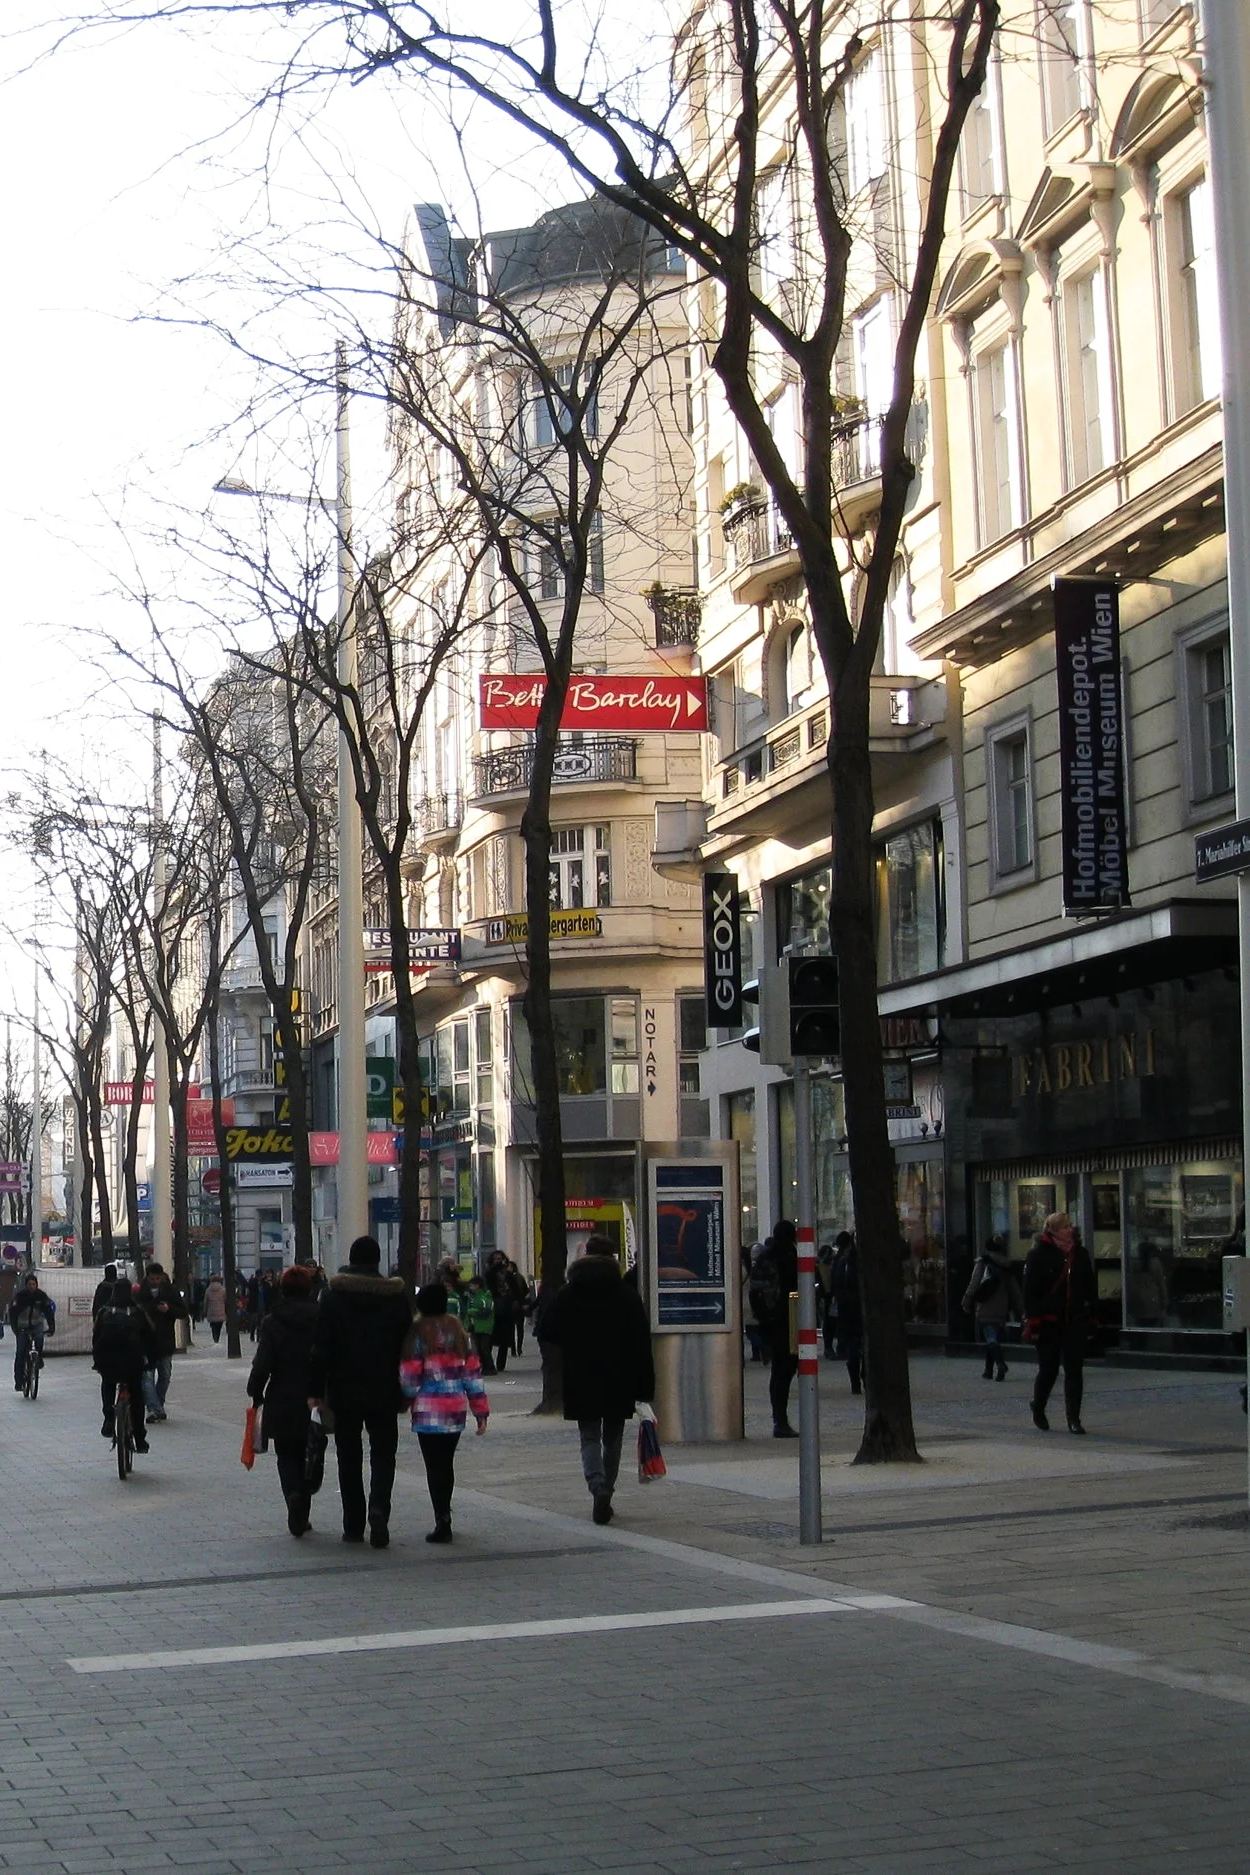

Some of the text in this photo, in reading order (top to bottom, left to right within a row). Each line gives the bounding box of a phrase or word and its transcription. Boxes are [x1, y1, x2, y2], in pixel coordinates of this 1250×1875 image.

[483, 679, 682, 728] Bett Barclay
[1067, 635, 1096, 899] Hofmobiliendepot.
[1091, 591, 1122, 900] Möbel Museum Wien
[713, 889, 735, 1011] GEOX
[644, 1008, 656, 1078] NOTAR
[1018, 1028, 1157, 1096] FABRINI
[888, 1106, 918, 1117] BRINI
